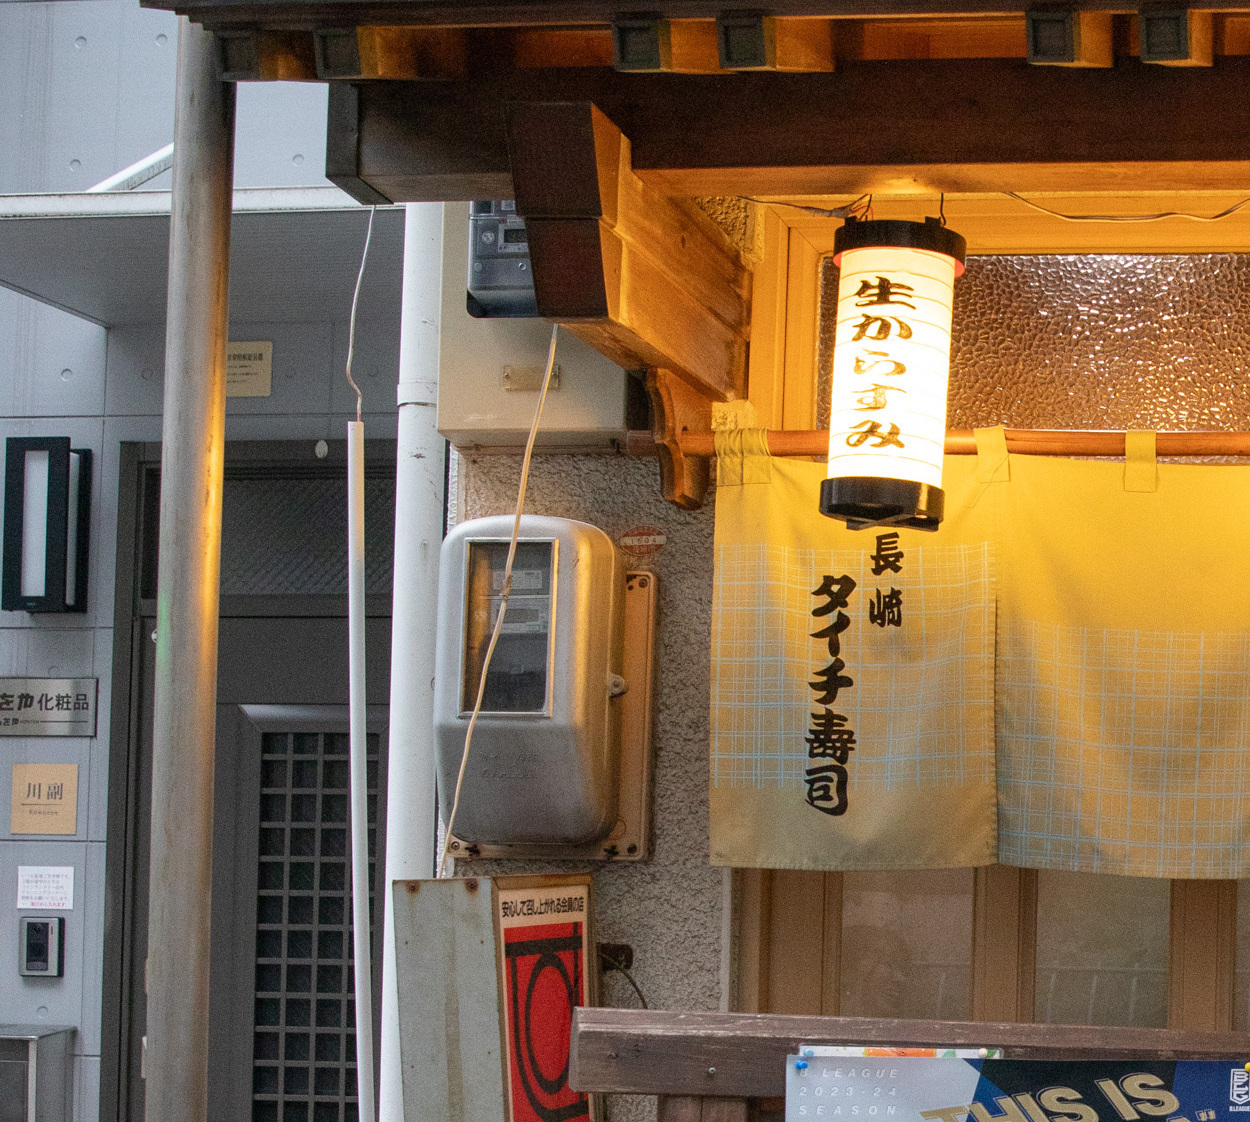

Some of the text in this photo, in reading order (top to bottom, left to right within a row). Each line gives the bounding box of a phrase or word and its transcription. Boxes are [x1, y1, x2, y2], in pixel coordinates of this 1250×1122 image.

[846, 275, 916, 449] 生からすみ
[799, 1106, 896, 1115] SEASON
[1095, 1072, 1180, 1120] IS
